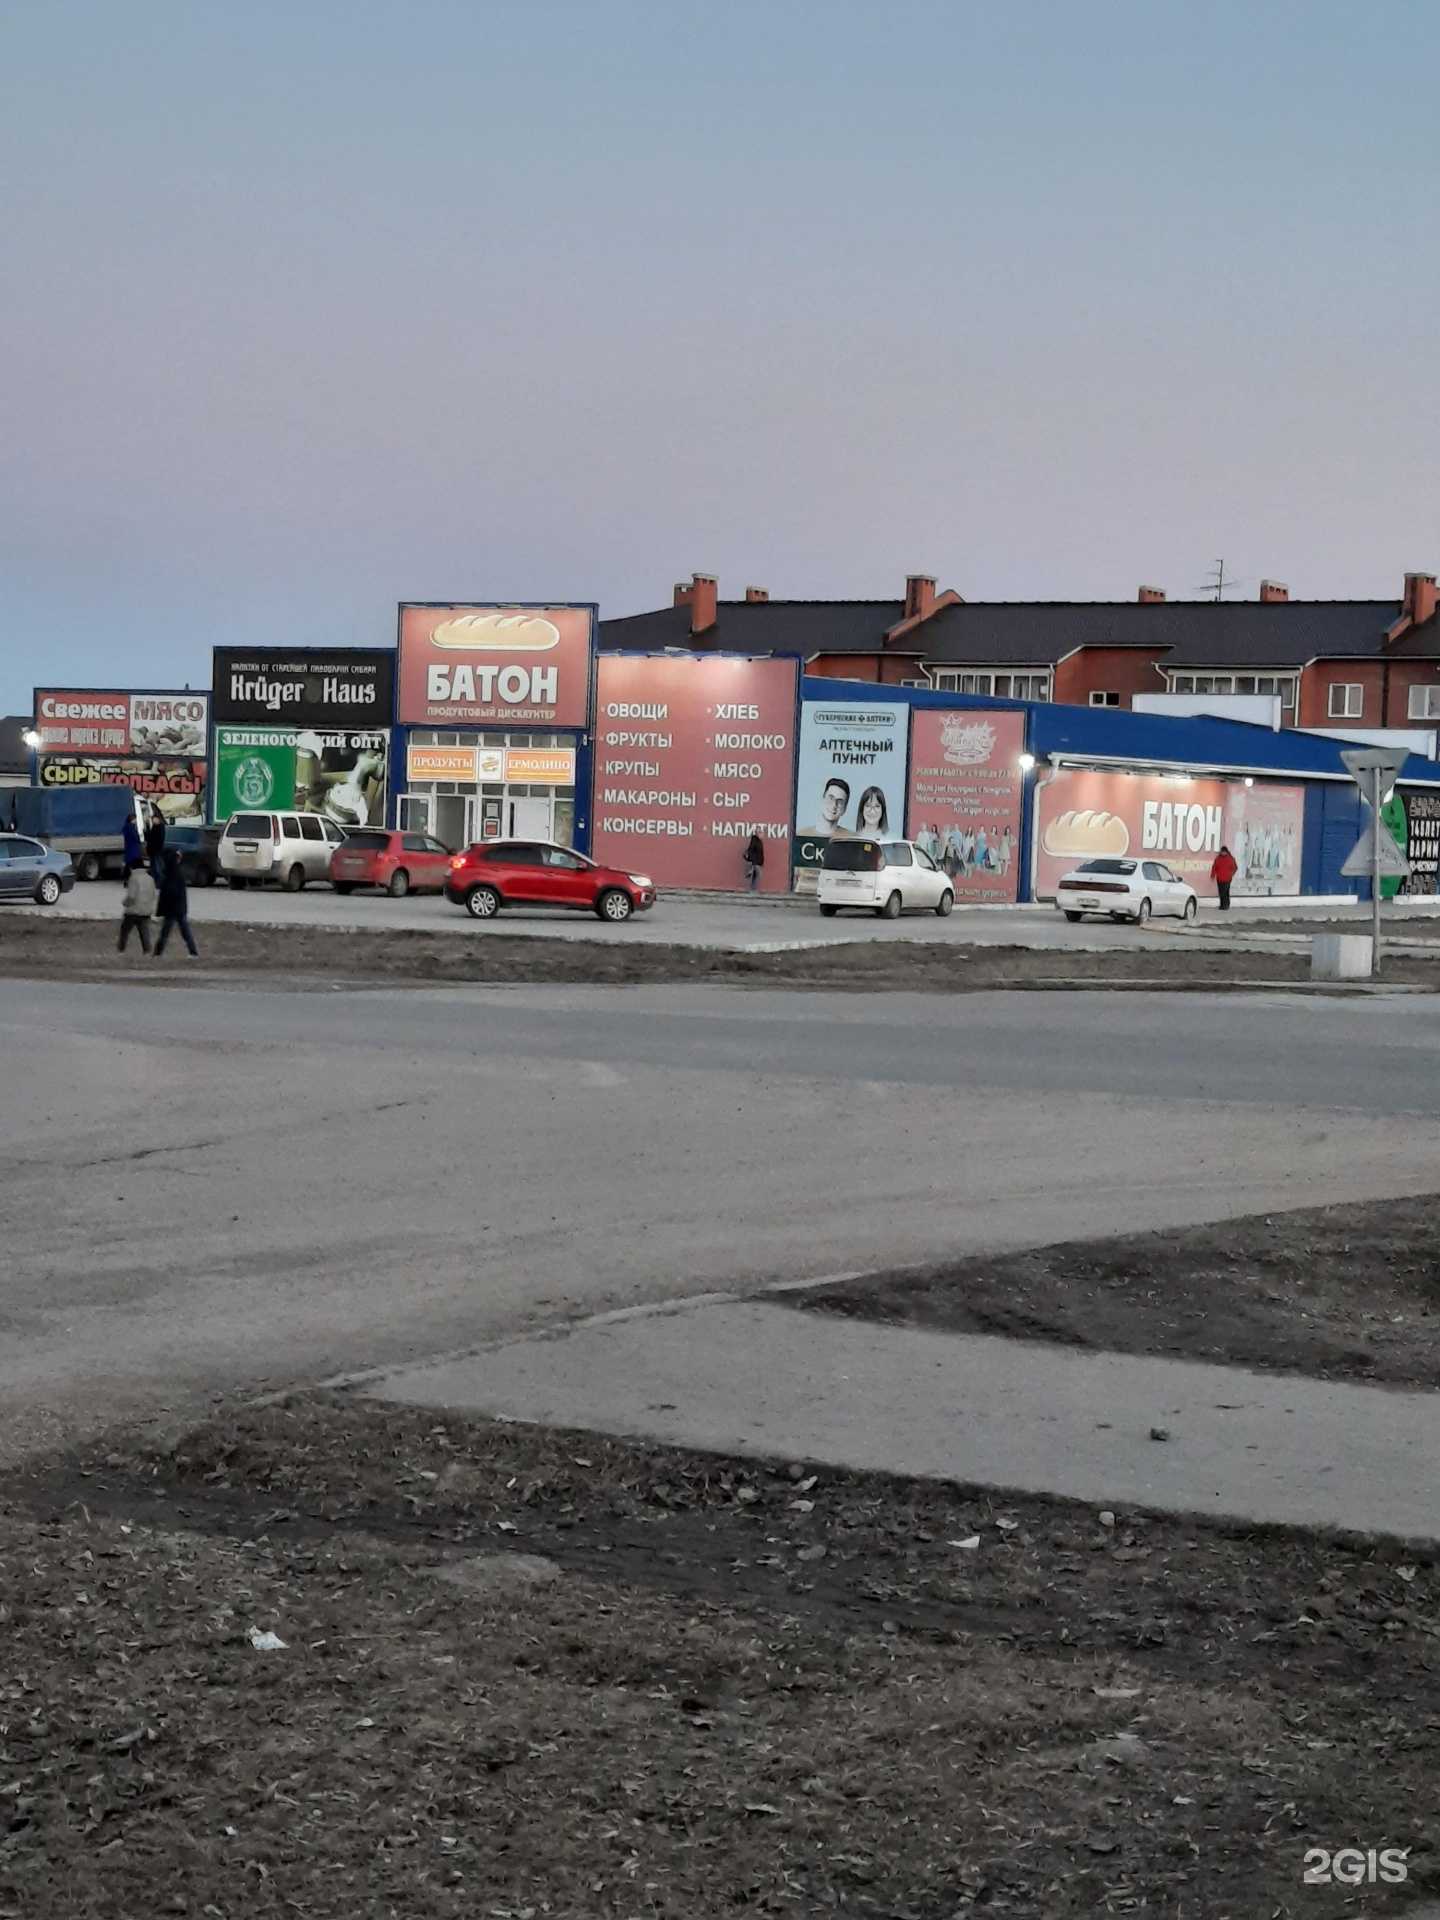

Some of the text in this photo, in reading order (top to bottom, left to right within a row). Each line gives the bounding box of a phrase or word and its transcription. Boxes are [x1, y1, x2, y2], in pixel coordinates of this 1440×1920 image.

[231, 674, 376, 710] Krüger Haus
[427, 664, 558, 704] БАТОН
[41, 698, 204, 721] Свежее МЯСО
[606, 703, 668, 721] ОВОЩИ
[715, 704, 759, 720] ХЛЕБ
[351, 734, 382, 749] ОПТ
[605, 732, 673, 748] ФРУКТЫ
[714, 734, 786, 750] МОЛОКО
[818, 737, 894, 753] АПТЕЧНЫЙ
[413, 756, 473, 769] ПРОДУКТЫ
[832, 752, 876, 765] ПУНКТ
[605, 761, 659, 777] КРУПЫ
[713, 763, 762, 779] МЯСО
[603, 789, 696, 807] МАКАРОНЫ
[712, 791, 750, 808] СЫР
[602, 817, 693, 837] КОНСЕРВЫ
[1142, 800, 1223, 852] БАТОН
[1409, 839, 1439, 858] ВАРИМ
